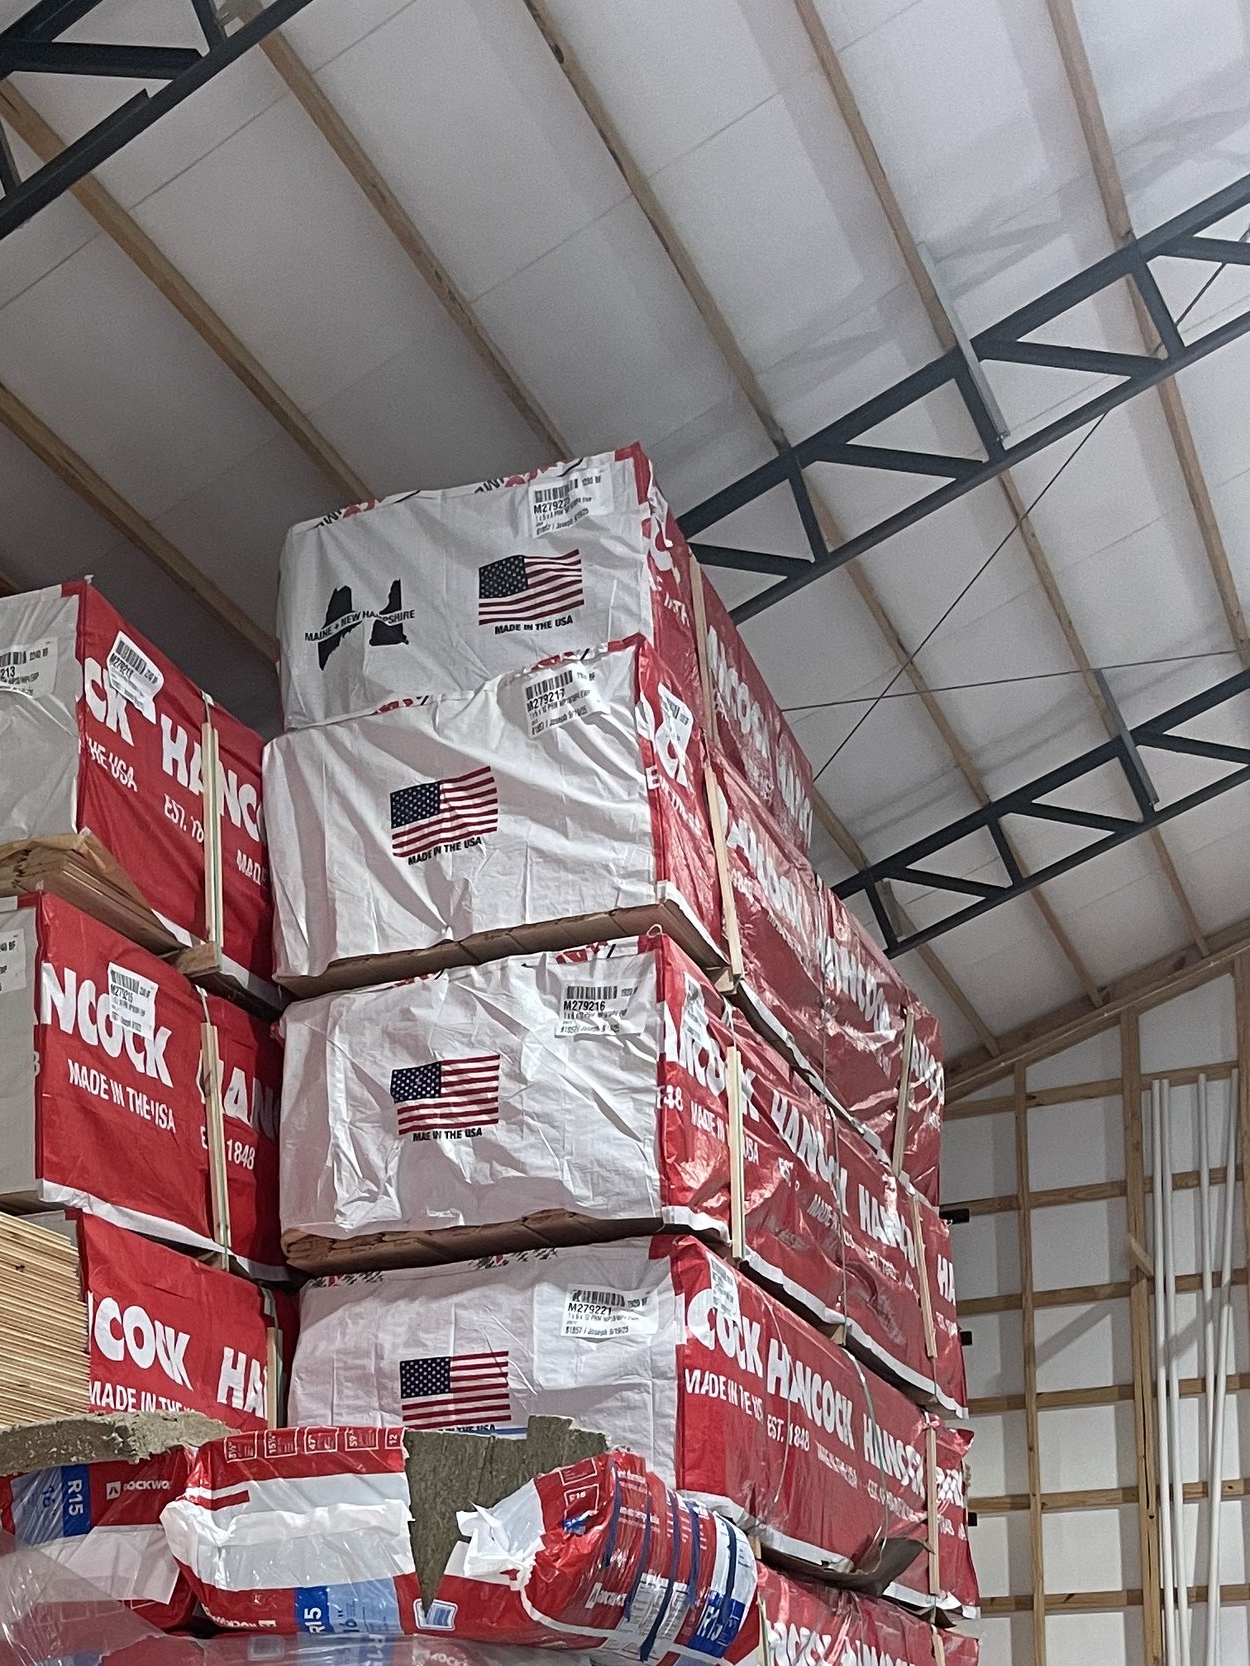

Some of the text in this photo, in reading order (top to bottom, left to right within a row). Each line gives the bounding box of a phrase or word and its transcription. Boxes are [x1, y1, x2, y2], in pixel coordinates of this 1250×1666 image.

[304, 627, 333, 642] MAINE
[340, 609, 362, 628] NEW
[494, 615, 574, 635] MADE IN THE USA
[108, 752, 138, 792] USA
[407, 852, 431, 867] MADE
[444, 841, 462, 854] THE
[463, 835, 482, 851] USA
[563, 1000, 606, 1011] M279216
[68, 1059, 176, 1134] MADE IN THE USA
[444, 1129, 463, 1140] THE
[464, 1127, 483, 1138] USA
[225, 1137, 256, 1171] 1848
[567, 1302, 612, 1316] M279221
[89, 1380, 137, 1413] MADE
[140, 1391, 157, 1412] IN
[767, 1413, 810, 1453] EST. 1848
[67, 1478, 84, 1517] R15
[123, 1479, 172, 1491] OCKWO
